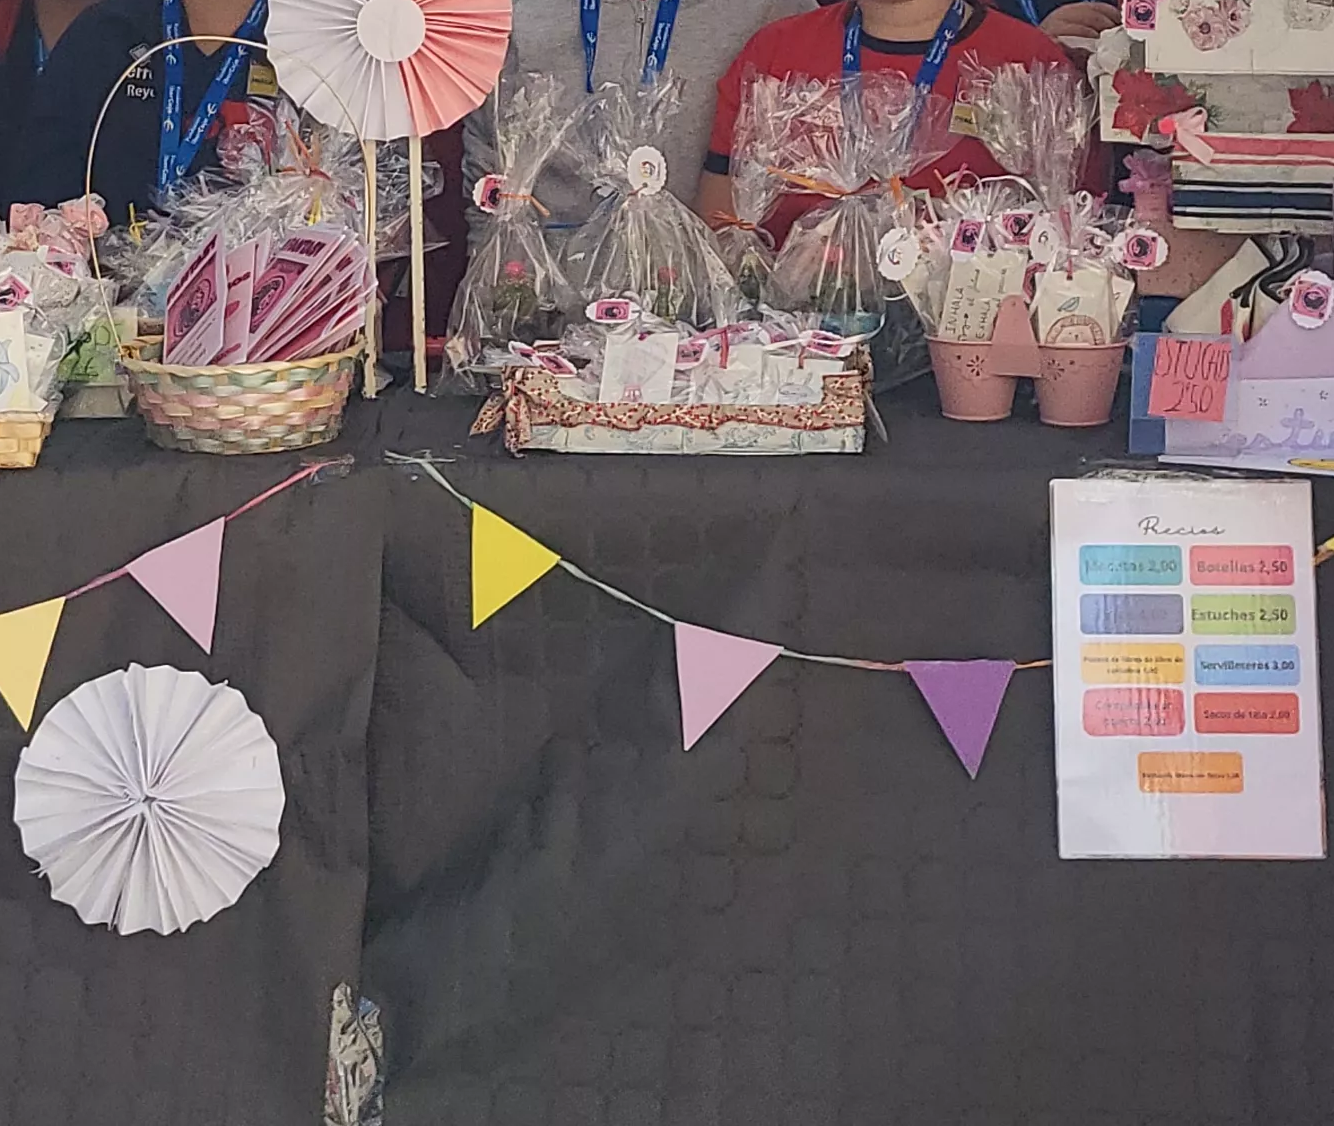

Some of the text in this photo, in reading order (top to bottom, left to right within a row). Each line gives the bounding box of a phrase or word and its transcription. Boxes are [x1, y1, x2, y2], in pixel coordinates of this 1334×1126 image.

[1138, 515, 1226, 537] Precios
[1197, 559, 1289, 577] Botellas 2,50
[1191, 607, 1289, 623] Estuches 2,50
